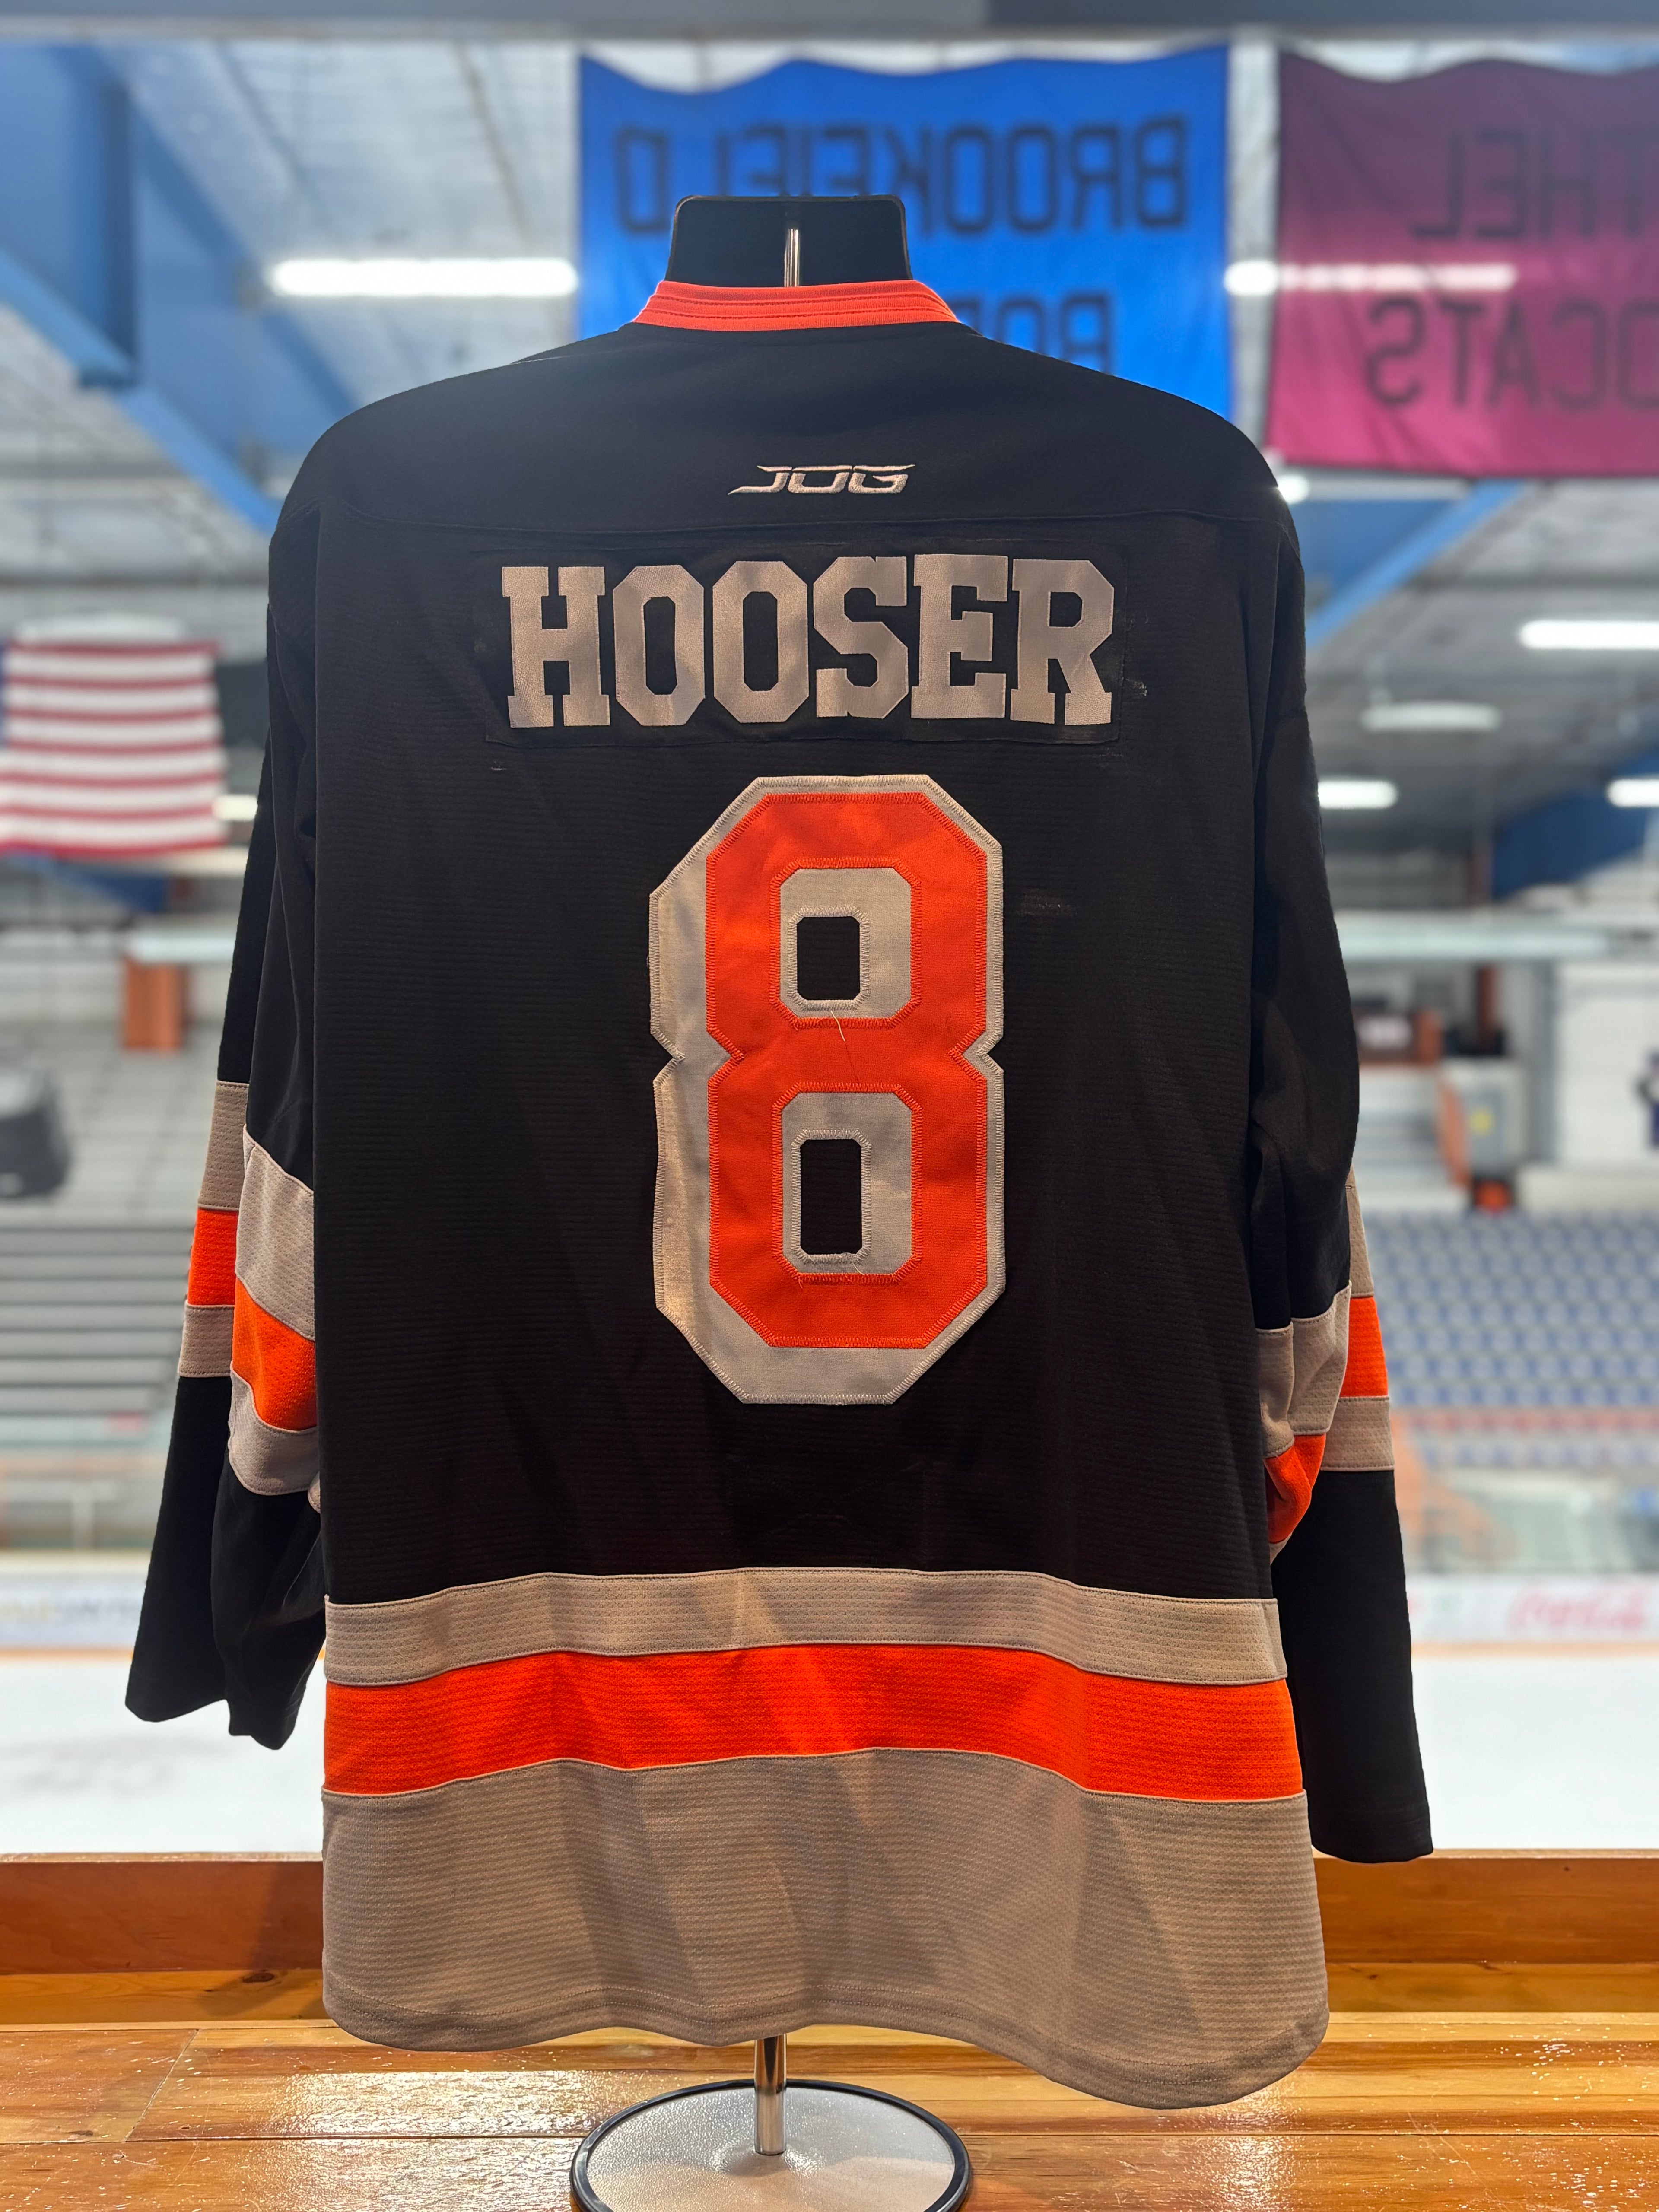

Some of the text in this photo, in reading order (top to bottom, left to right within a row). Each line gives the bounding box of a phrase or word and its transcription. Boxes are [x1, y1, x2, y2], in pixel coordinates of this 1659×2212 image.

[728, 465, 915, 495] JOG
[502, 554, 1115, 728] HOOSER
[648, 775, 1005, 1405] 8
